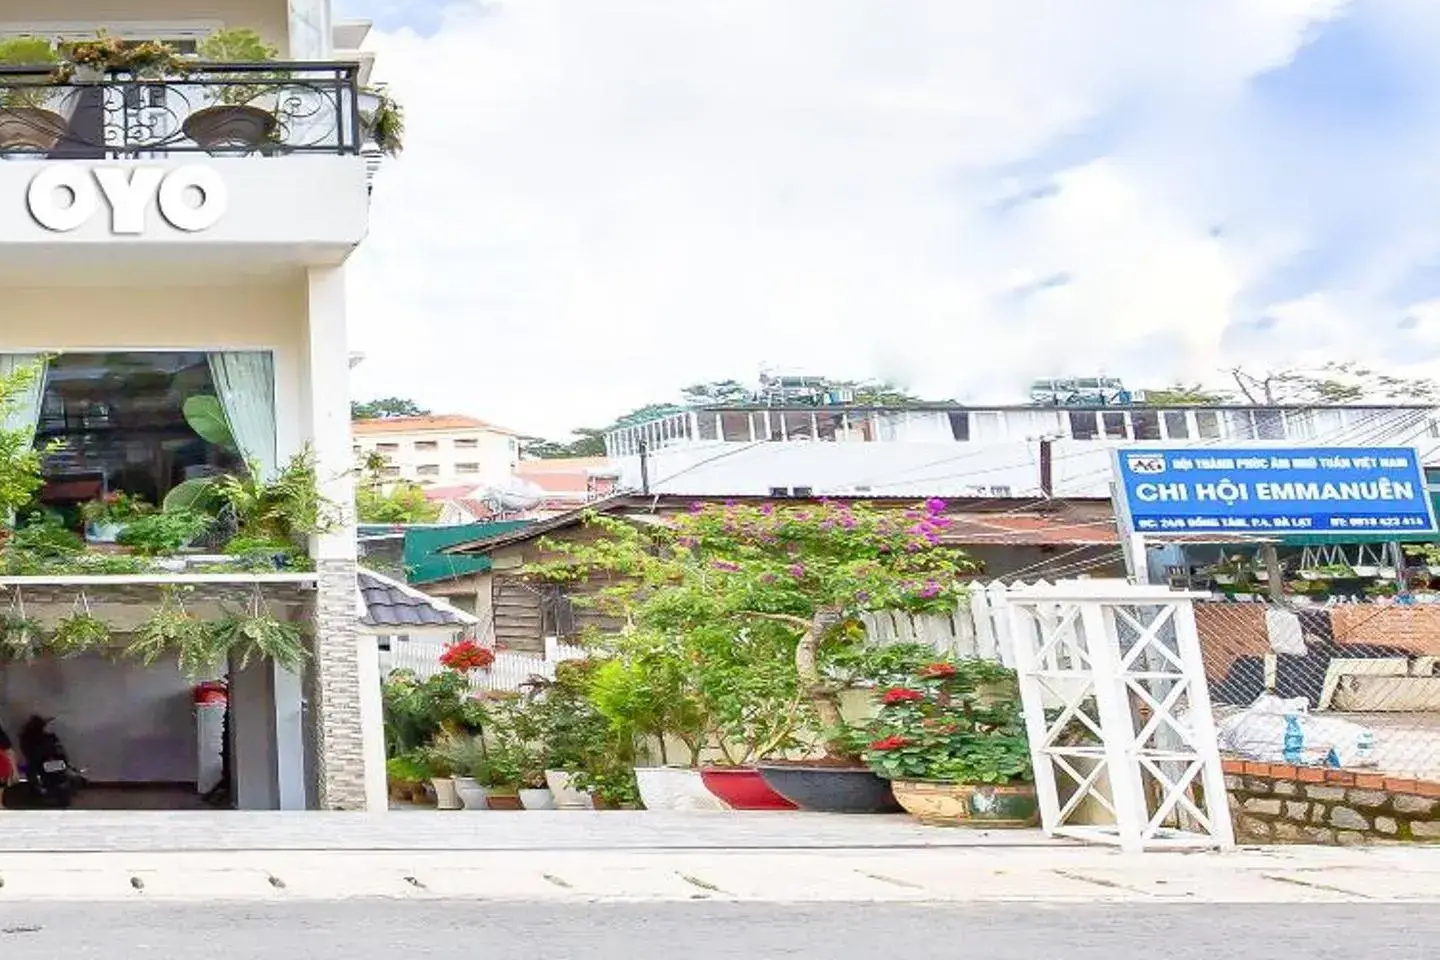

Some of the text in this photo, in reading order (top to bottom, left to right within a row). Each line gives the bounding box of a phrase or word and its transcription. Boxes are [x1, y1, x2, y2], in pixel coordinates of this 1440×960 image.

[26, 163, 228, 236] OYO
[1136, 476, 1414, 507] CHI HỘI EMMANUÊN
